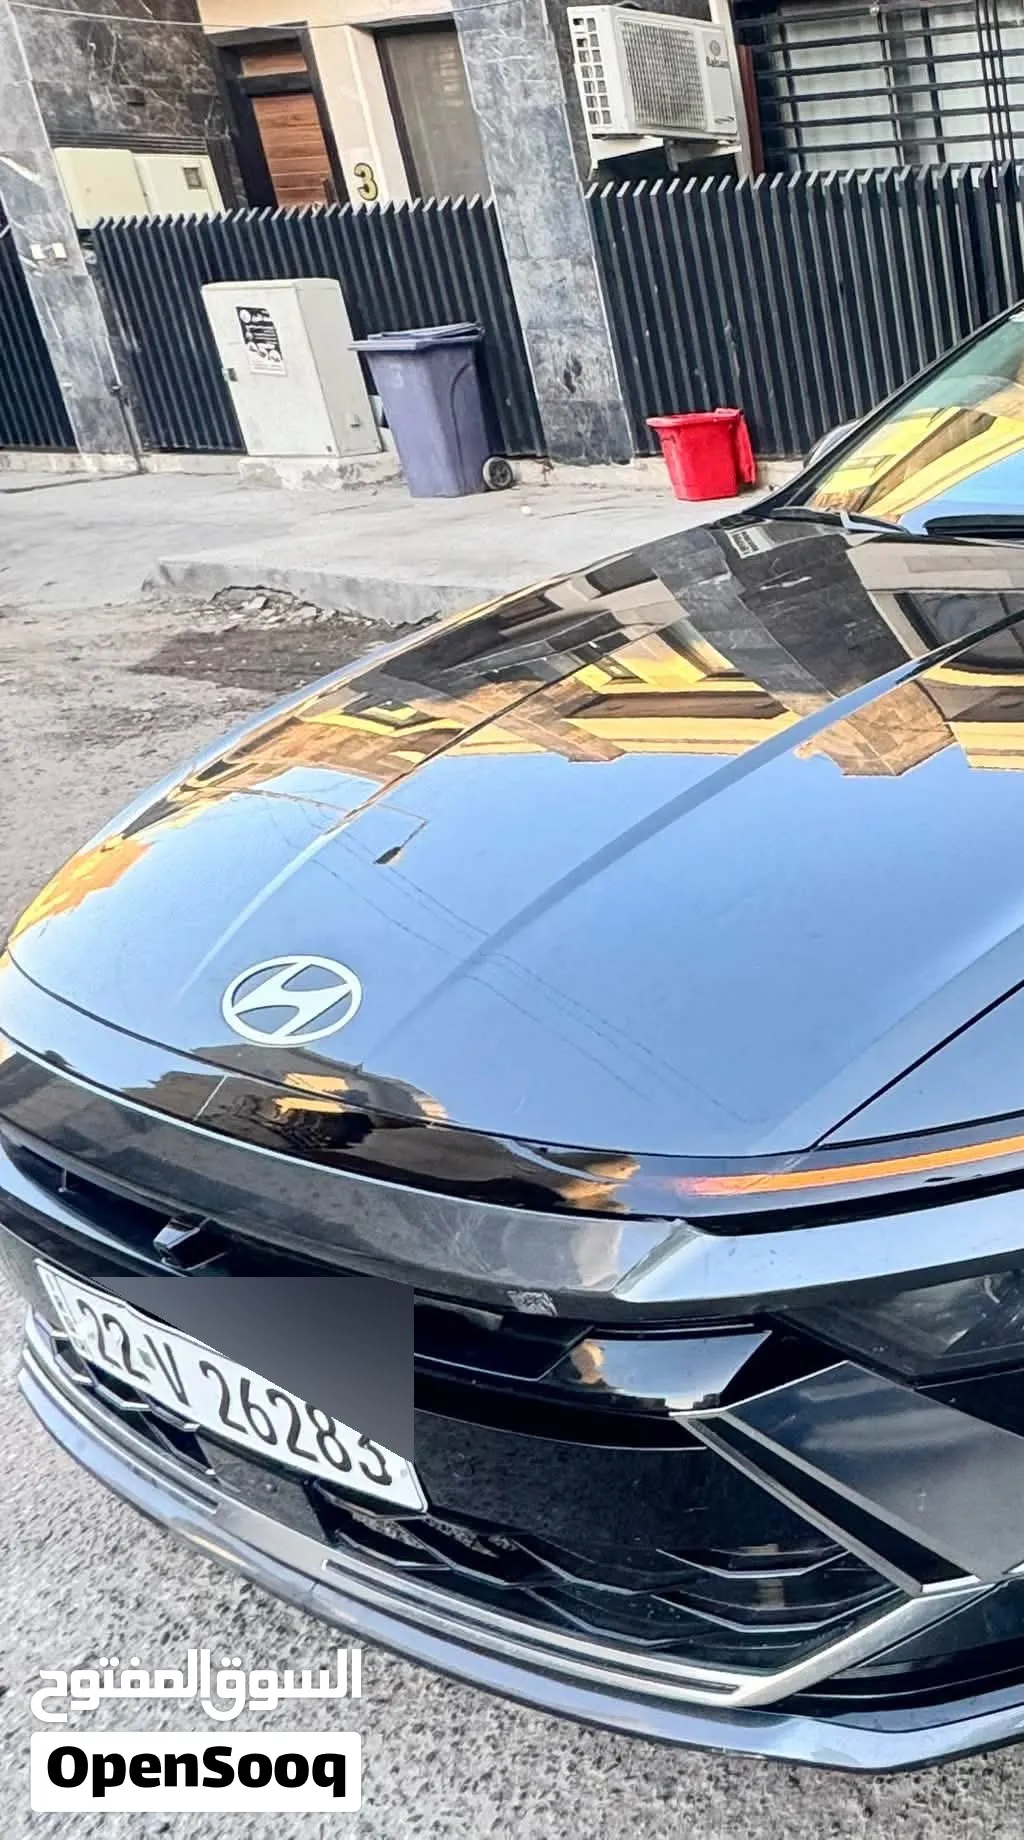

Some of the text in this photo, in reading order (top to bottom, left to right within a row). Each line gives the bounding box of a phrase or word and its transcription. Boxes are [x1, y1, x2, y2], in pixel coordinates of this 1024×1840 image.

[354, 162, 378, 201] 3
[75, 1298, 151, 1383] 22
[143, 1333, 191, 1407] V
